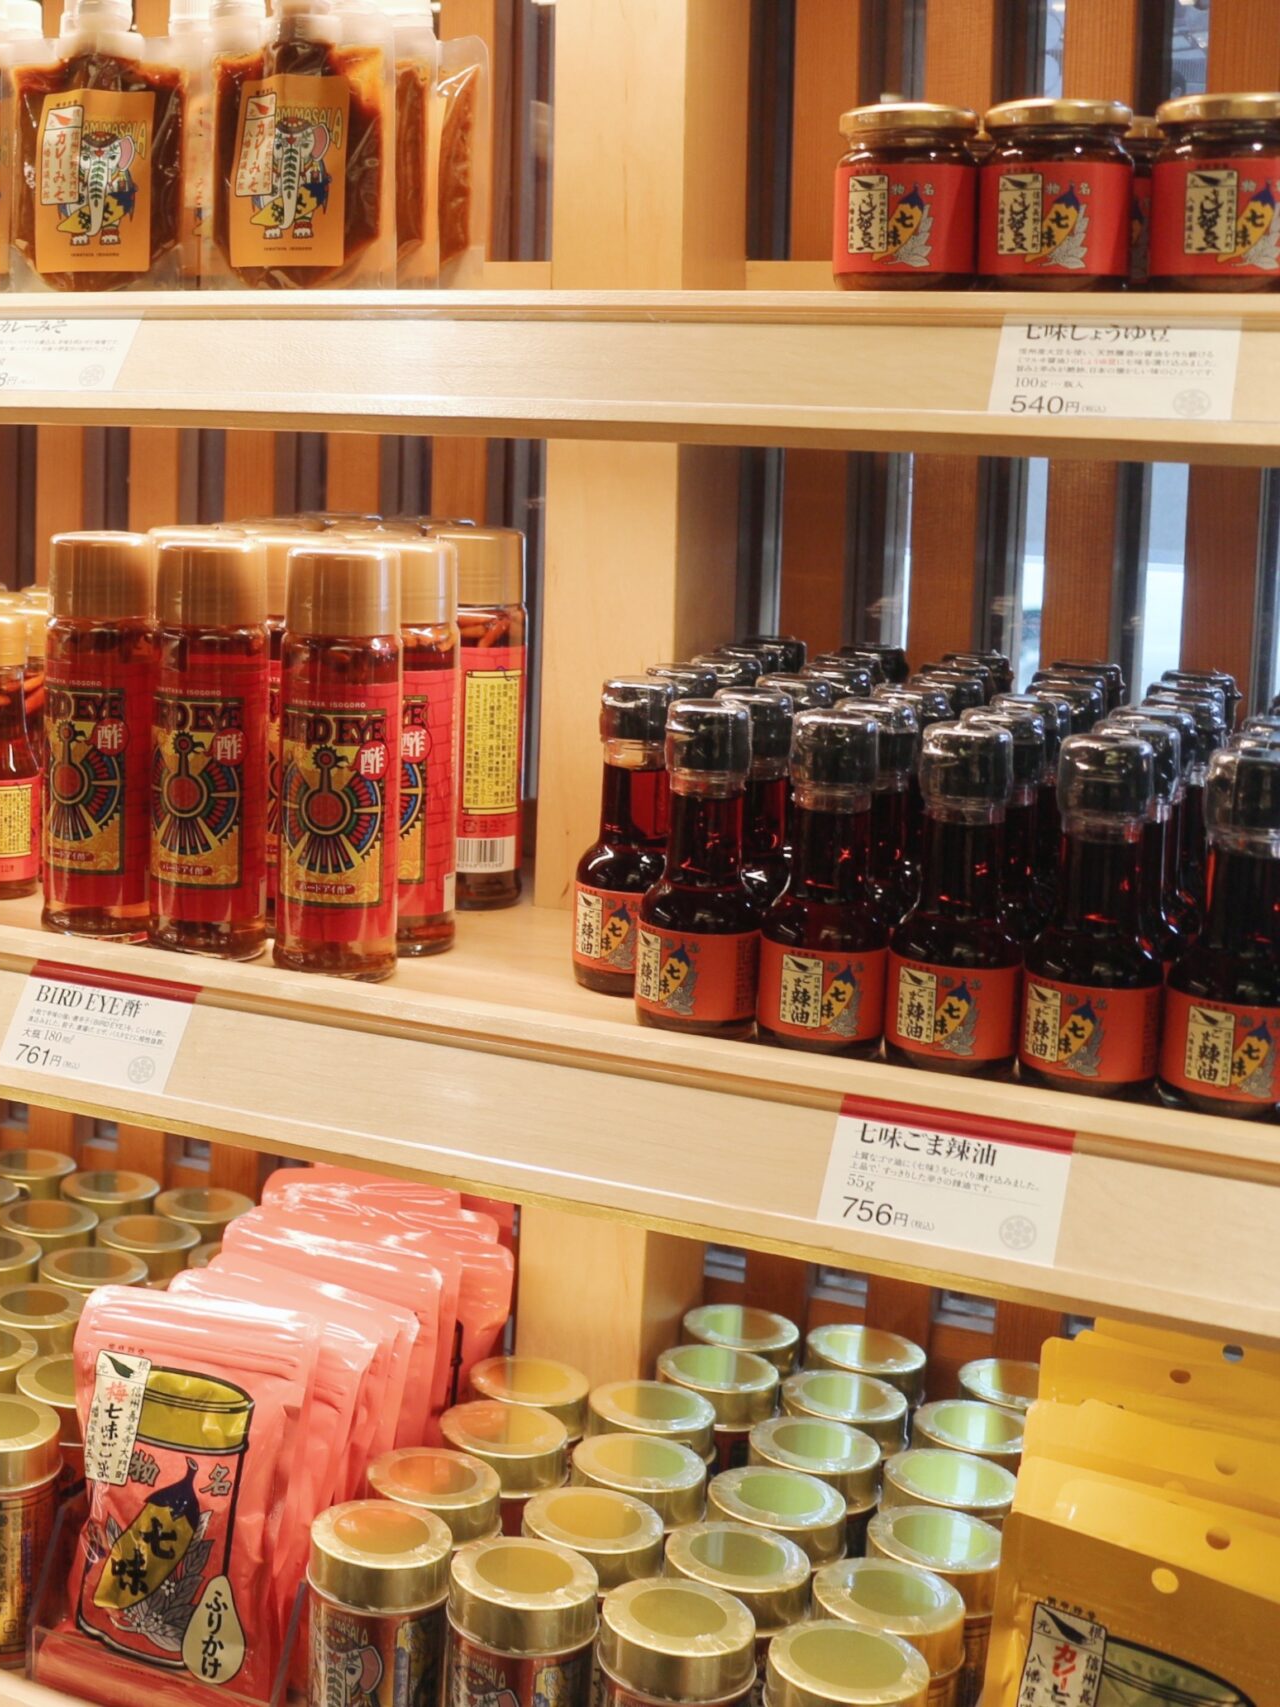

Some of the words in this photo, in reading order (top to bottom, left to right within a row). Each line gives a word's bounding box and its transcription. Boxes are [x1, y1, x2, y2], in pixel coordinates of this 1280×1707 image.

[102, 120, 148, 160] MASALA
[54, 132, 67, 203] カレーみそ
[887, 210, 915, 247] 七味
[1041, 211, 1069, 247] 七味
[1236, 209, 1265, 247] 七味
[1010, 395, 1080, 414] 540円
[336, 715, 385, 746] EYE
[601, 922, 622, 951] 七味
[659, 963, 681, 994] 七味
[36, 984, 83, 1008] BIRD
[819, 986, 846, 1018] 七味
[934, 1002, 961, 1035] 七味
[1058, 1021, 1087, 1053] 七味
[15, 1043, 62, 1068] 761円
[1231, 1043, 1261, 1077] 七味
[855, 1122, 998, 1168] 七味ごま辣油
[846, 1173, 875, 1193] 55g
[841, 1196, 909, 1228] 756円
[130, 1450, 161, 1485] 物
[200, 1464, 232, 1497] 名
[110, 1517, 178, 1597] 七味
[200, 1590, 230, 1679] ふりかけ
